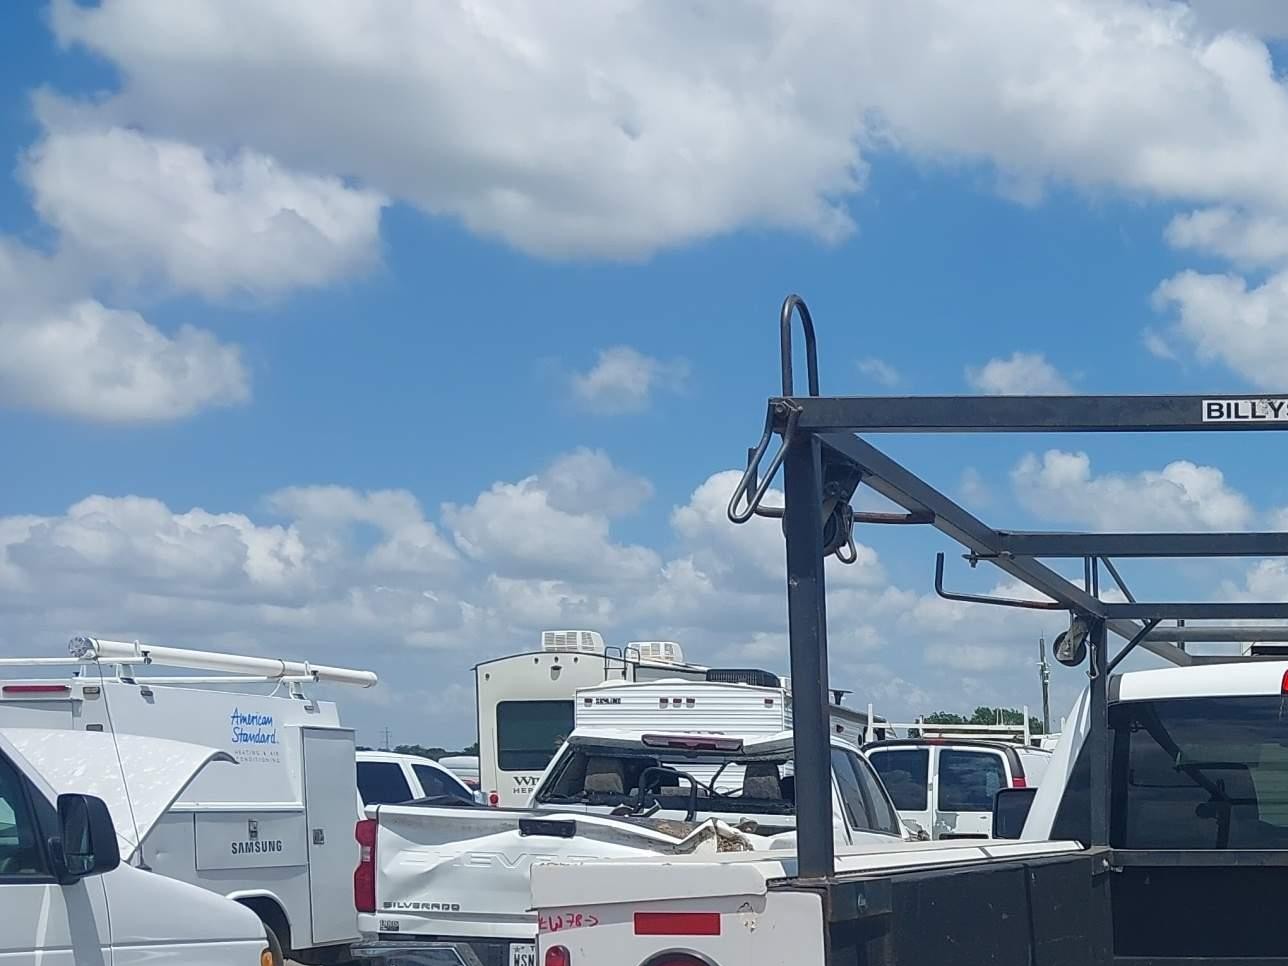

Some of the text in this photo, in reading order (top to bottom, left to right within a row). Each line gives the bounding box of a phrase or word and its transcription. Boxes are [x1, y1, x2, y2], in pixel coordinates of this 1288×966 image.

[230, 706, 273, 726] American
[231, 840, 282, 854] SAMSUNG
[383, 901, 460, 911] SILVERADO
